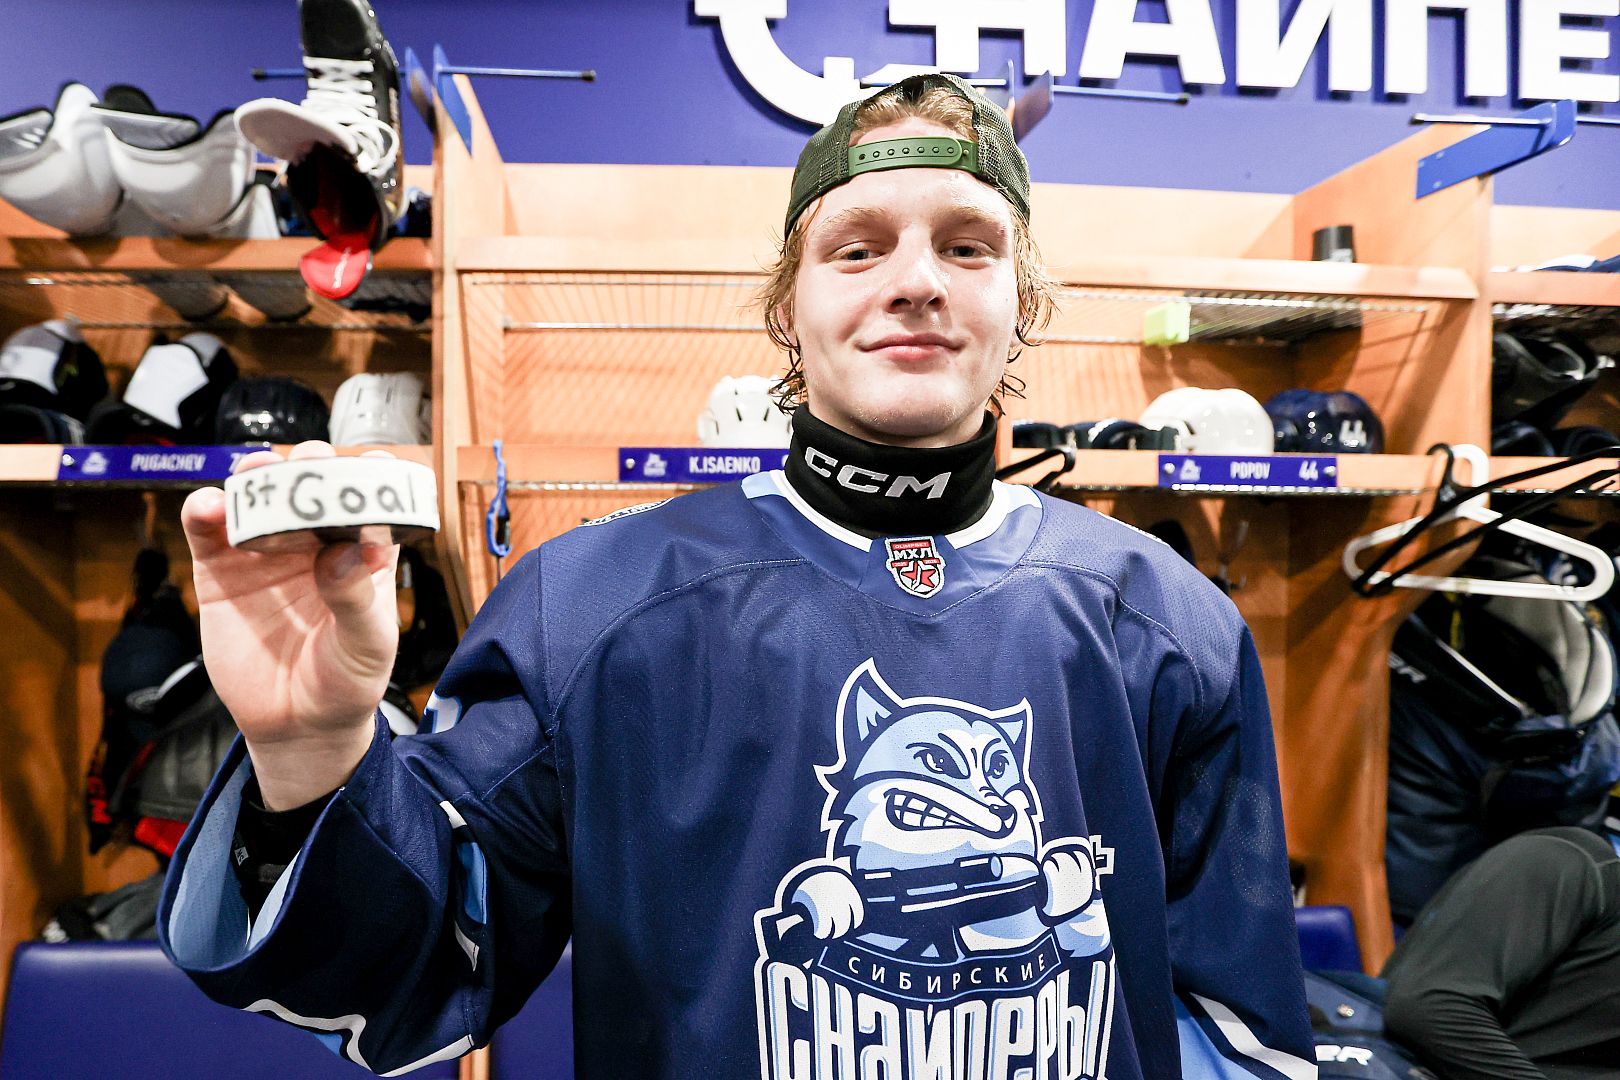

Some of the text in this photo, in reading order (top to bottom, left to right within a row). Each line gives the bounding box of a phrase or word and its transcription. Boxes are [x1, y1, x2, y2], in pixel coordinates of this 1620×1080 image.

[1339, 419, 1367, 447] 44
[130, 453, 206, 472] PUGACHEV
[689, 456, 761, 474] K.ISAENKO
[805, 446, 951, 499] CCM
[1230, 460, 1319, 481] POPOV 44
[234, 472, 416, 529] 1st Goal
[893, 548, 933, 560] МХЛ
[848, 953, 1045, 993] СИБИРСКИЕ
